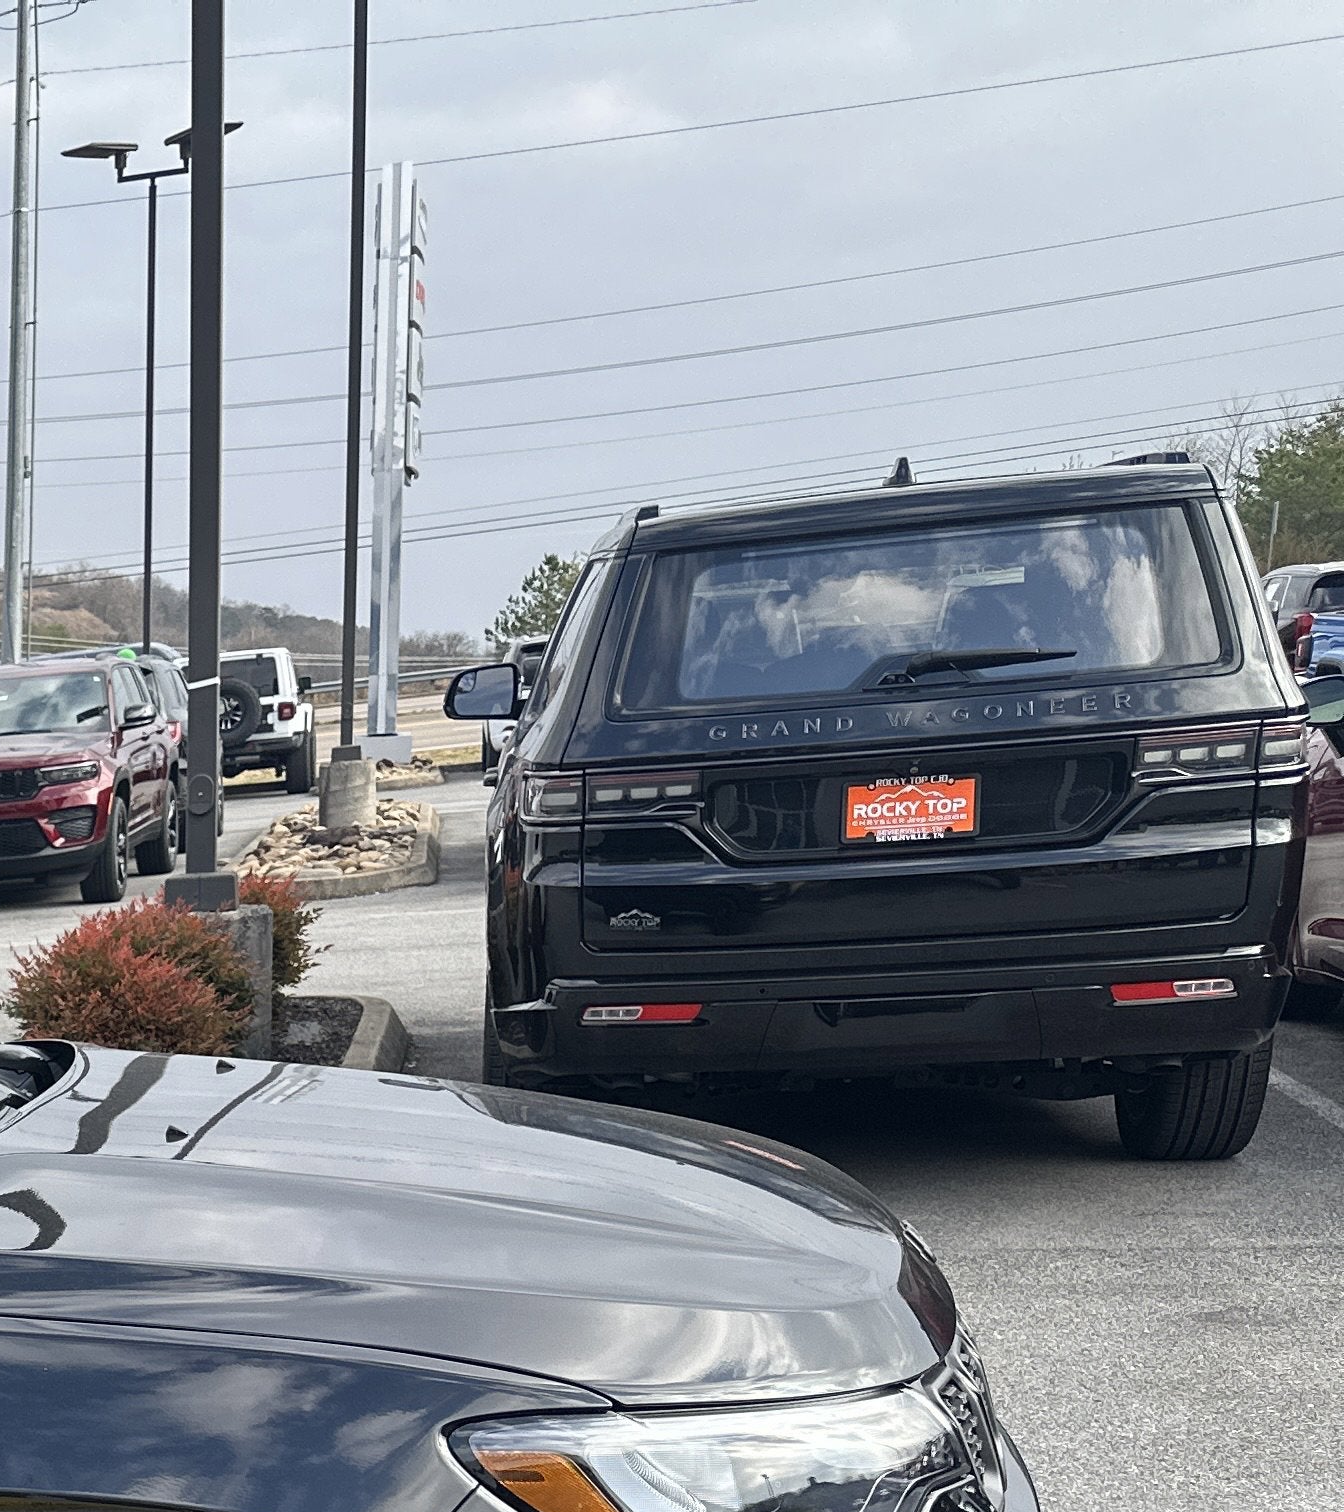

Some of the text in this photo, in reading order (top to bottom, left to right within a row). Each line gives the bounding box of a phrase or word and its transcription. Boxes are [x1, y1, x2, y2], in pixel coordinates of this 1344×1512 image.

[709, 692, 1132, 740] GRAND WAGONEER
[875, 777, 907, 788] ROCKY
[909, 775, 929, 785] TOP
[853, 797, 967, 819] ROCKY TOP
[852, 818, 905, 827] CHRYSLER
[928, 813, 968, 822] DODGE
